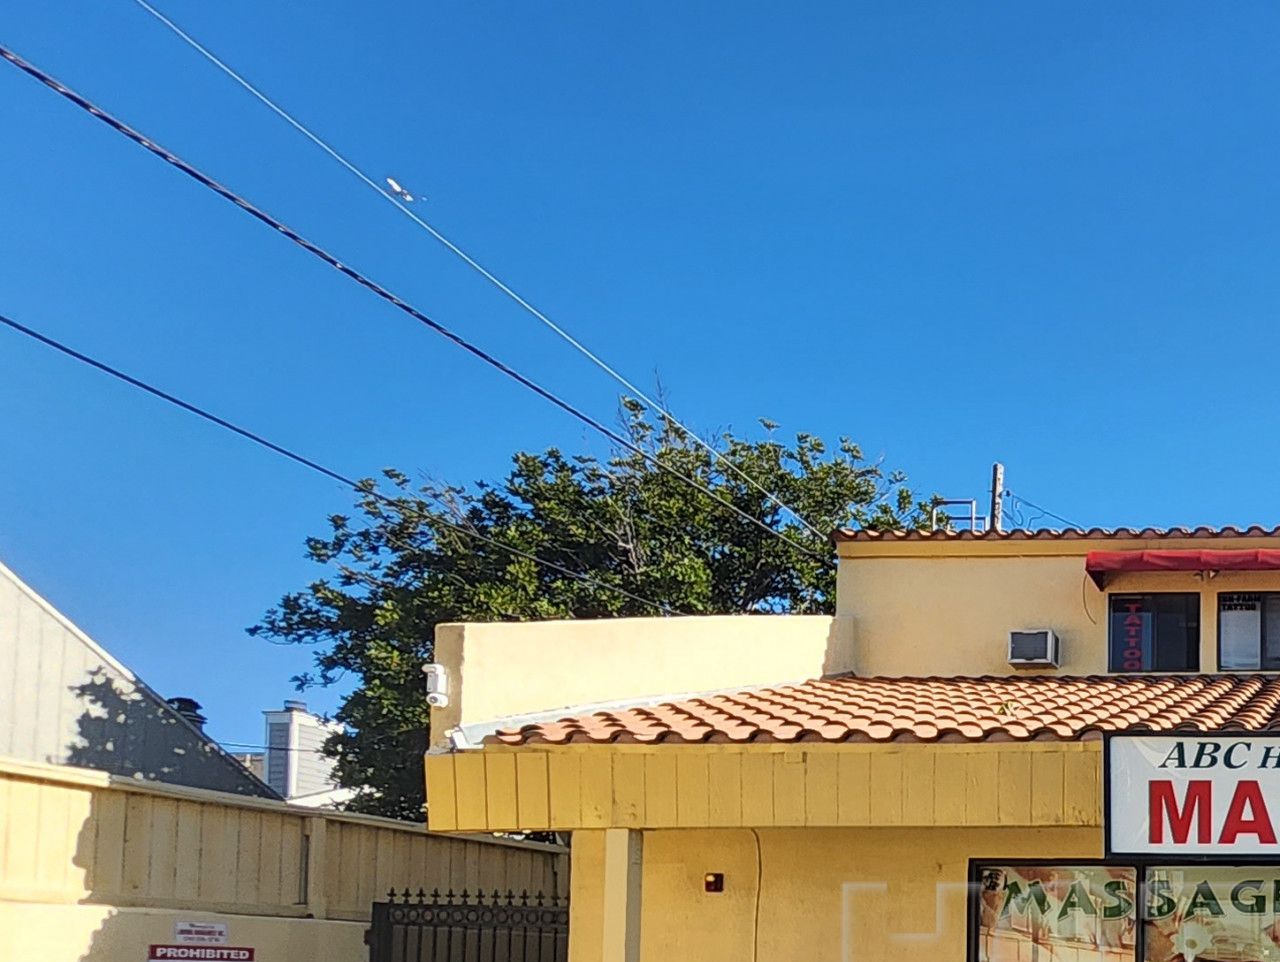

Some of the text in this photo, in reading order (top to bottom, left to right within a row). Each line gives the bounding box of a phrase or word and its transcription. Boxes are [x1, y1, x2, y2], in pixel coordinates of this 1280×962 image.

[1123, 603, 1142, 670] TATTOO
[1158, 741, 1251, 769] ABC
[155, 947, 250, 959] PROHIBITED
